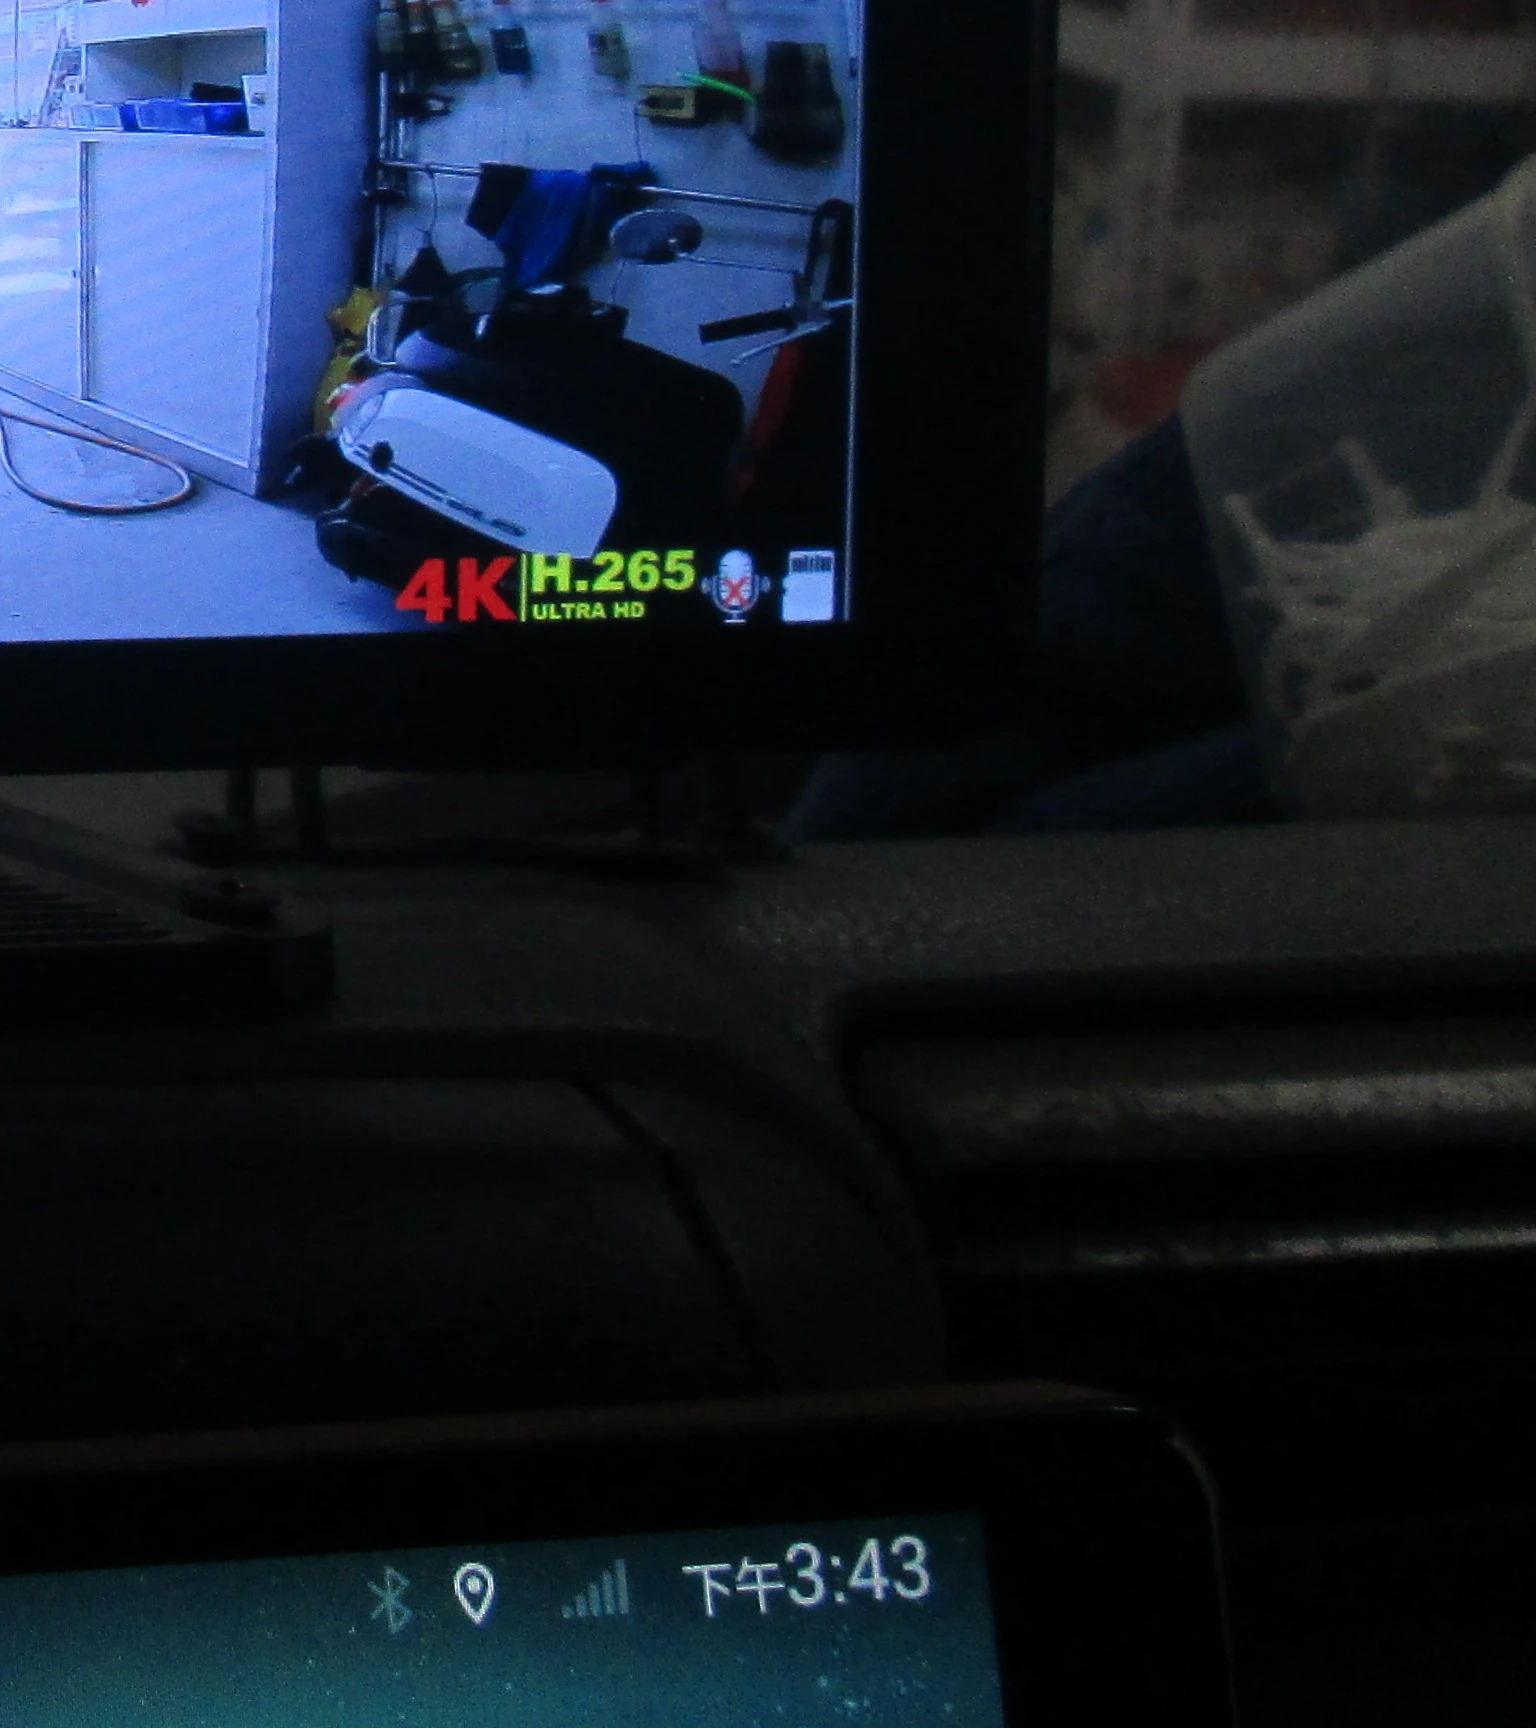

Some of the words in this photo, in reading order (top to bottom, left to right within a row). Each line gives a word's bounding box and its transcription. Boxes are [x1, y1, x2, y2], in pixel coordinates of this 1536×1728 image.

[395, 556, 519, 622] 4K
[530, 549, 696, 593] H.265
[532, 602, 607, 621] ULTRA
[613, 601, 646, 620] HD
[681, 1535, 930, 1618] 下午3:43
